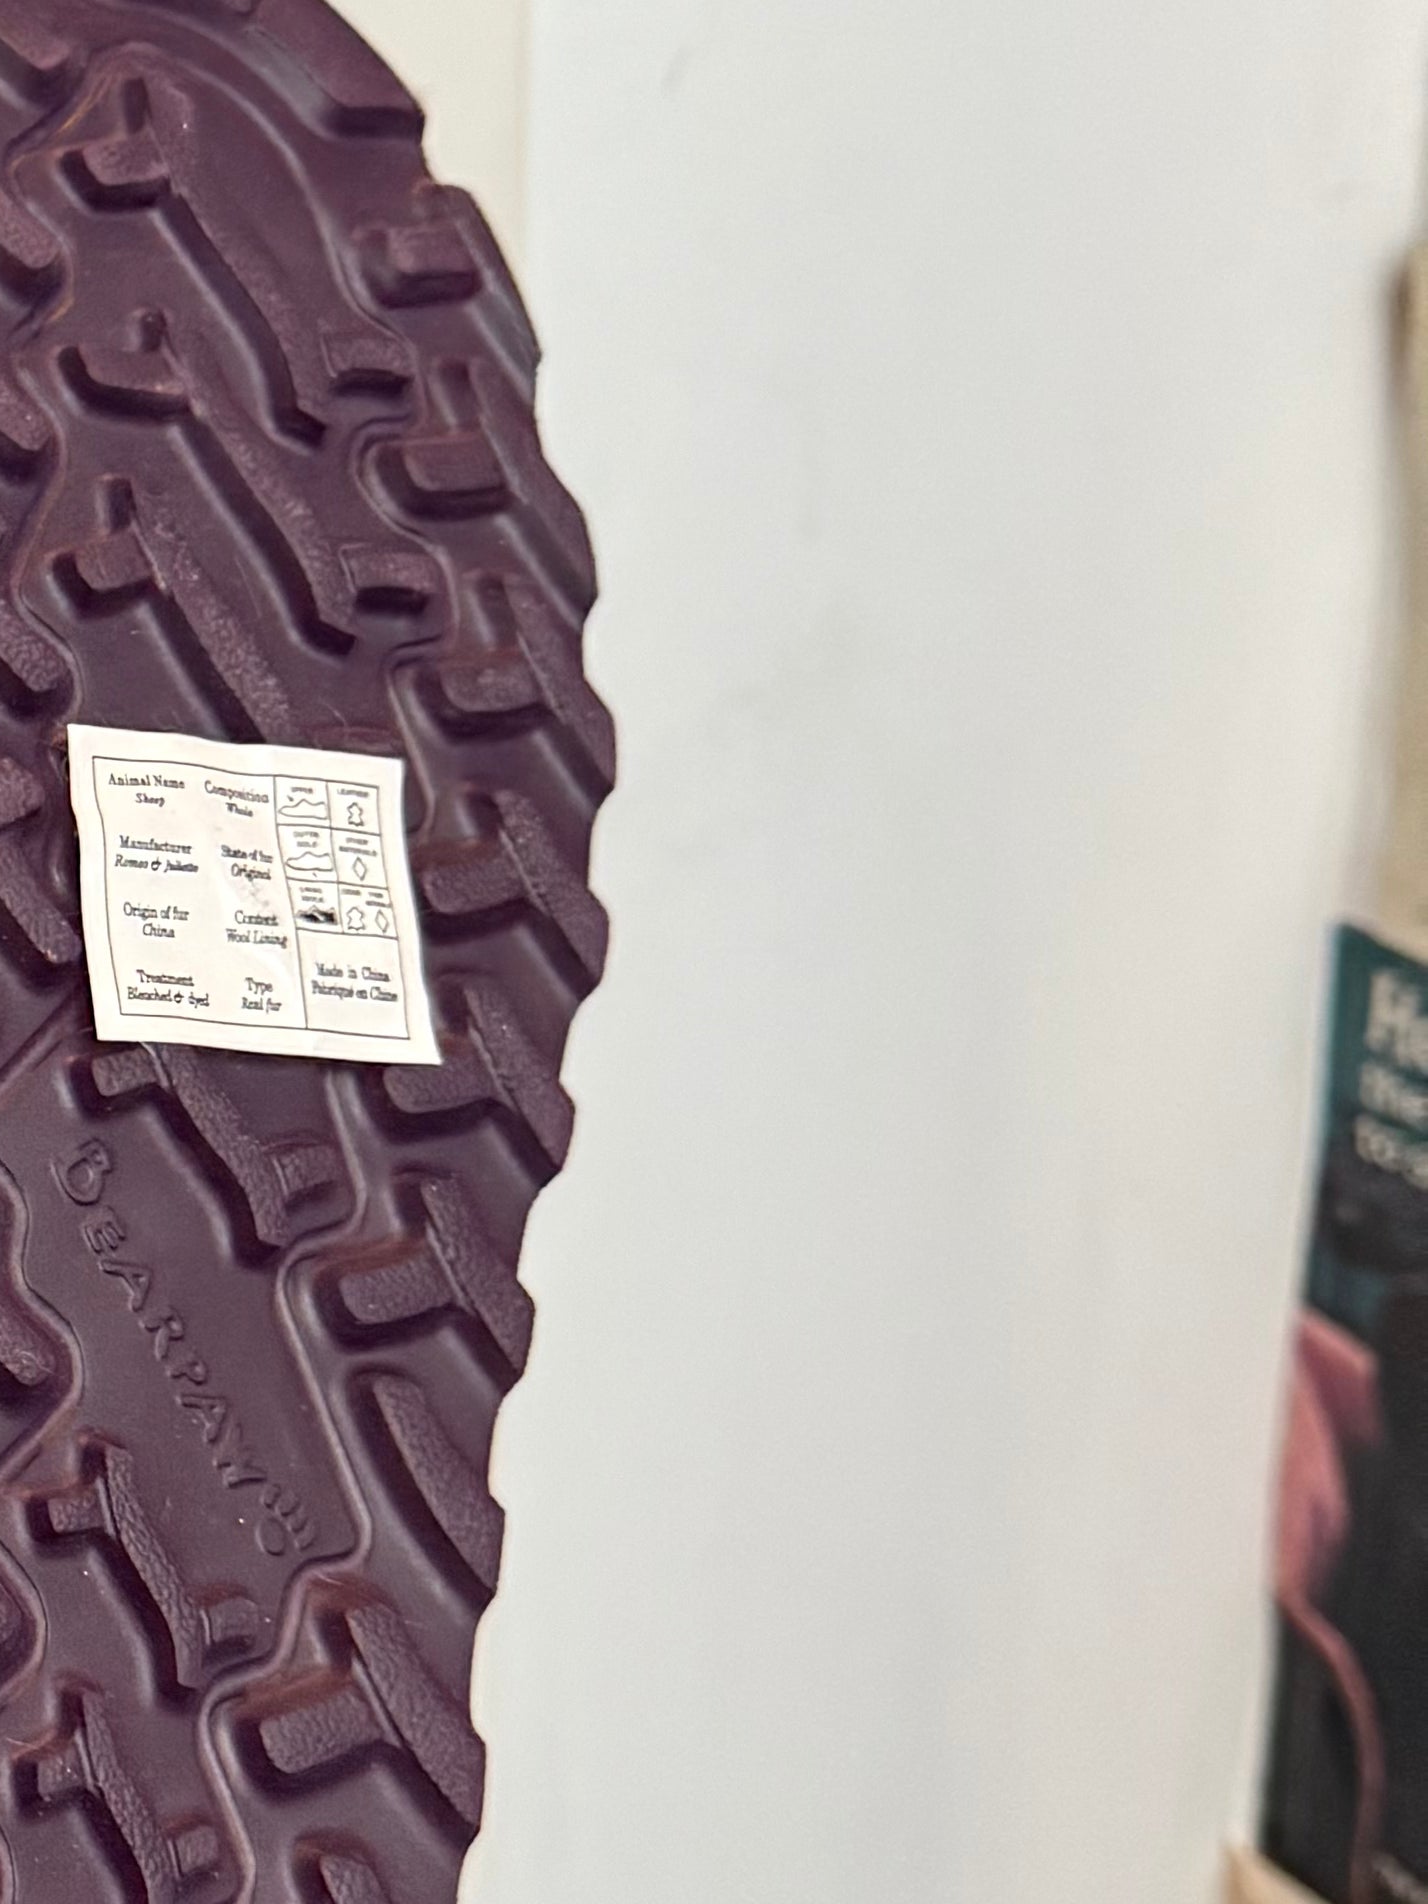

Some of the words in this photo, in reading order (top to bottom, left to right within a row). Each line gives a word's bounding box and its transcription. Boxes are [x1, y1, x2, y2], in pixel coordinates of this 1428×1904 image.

[108, 773, 151, 787] Animal
[153, 774, 185, 789] Name
[135, 792, 165, 807] Sheep
[119, 834, 193, 855] Manufacturer
[150, 856, 162, 872] &
[123, 901, 158, 921] Origin
[160, 905, 172, 920] of
[172, 906, 190, 921] fur
[142, 923, 175, 938] China
[225, 927, 251, 944] Wool
[252, 930, 288, 949] Lining
[136, 968, 195, 987] Treatment
[315, 961, 344, 978] Made
[347, 964, 358, 980] in
[361, 966, 391, 983] China
[244, 977, 274, 996] Type
[127, 986, 172, 1003] Bleached
[173, 990, 185, 1004] &
[187, 992, 210, 1008] dyed
[241, 997, 264, 1010] Real
[265, 997, 283, 1014] fur
